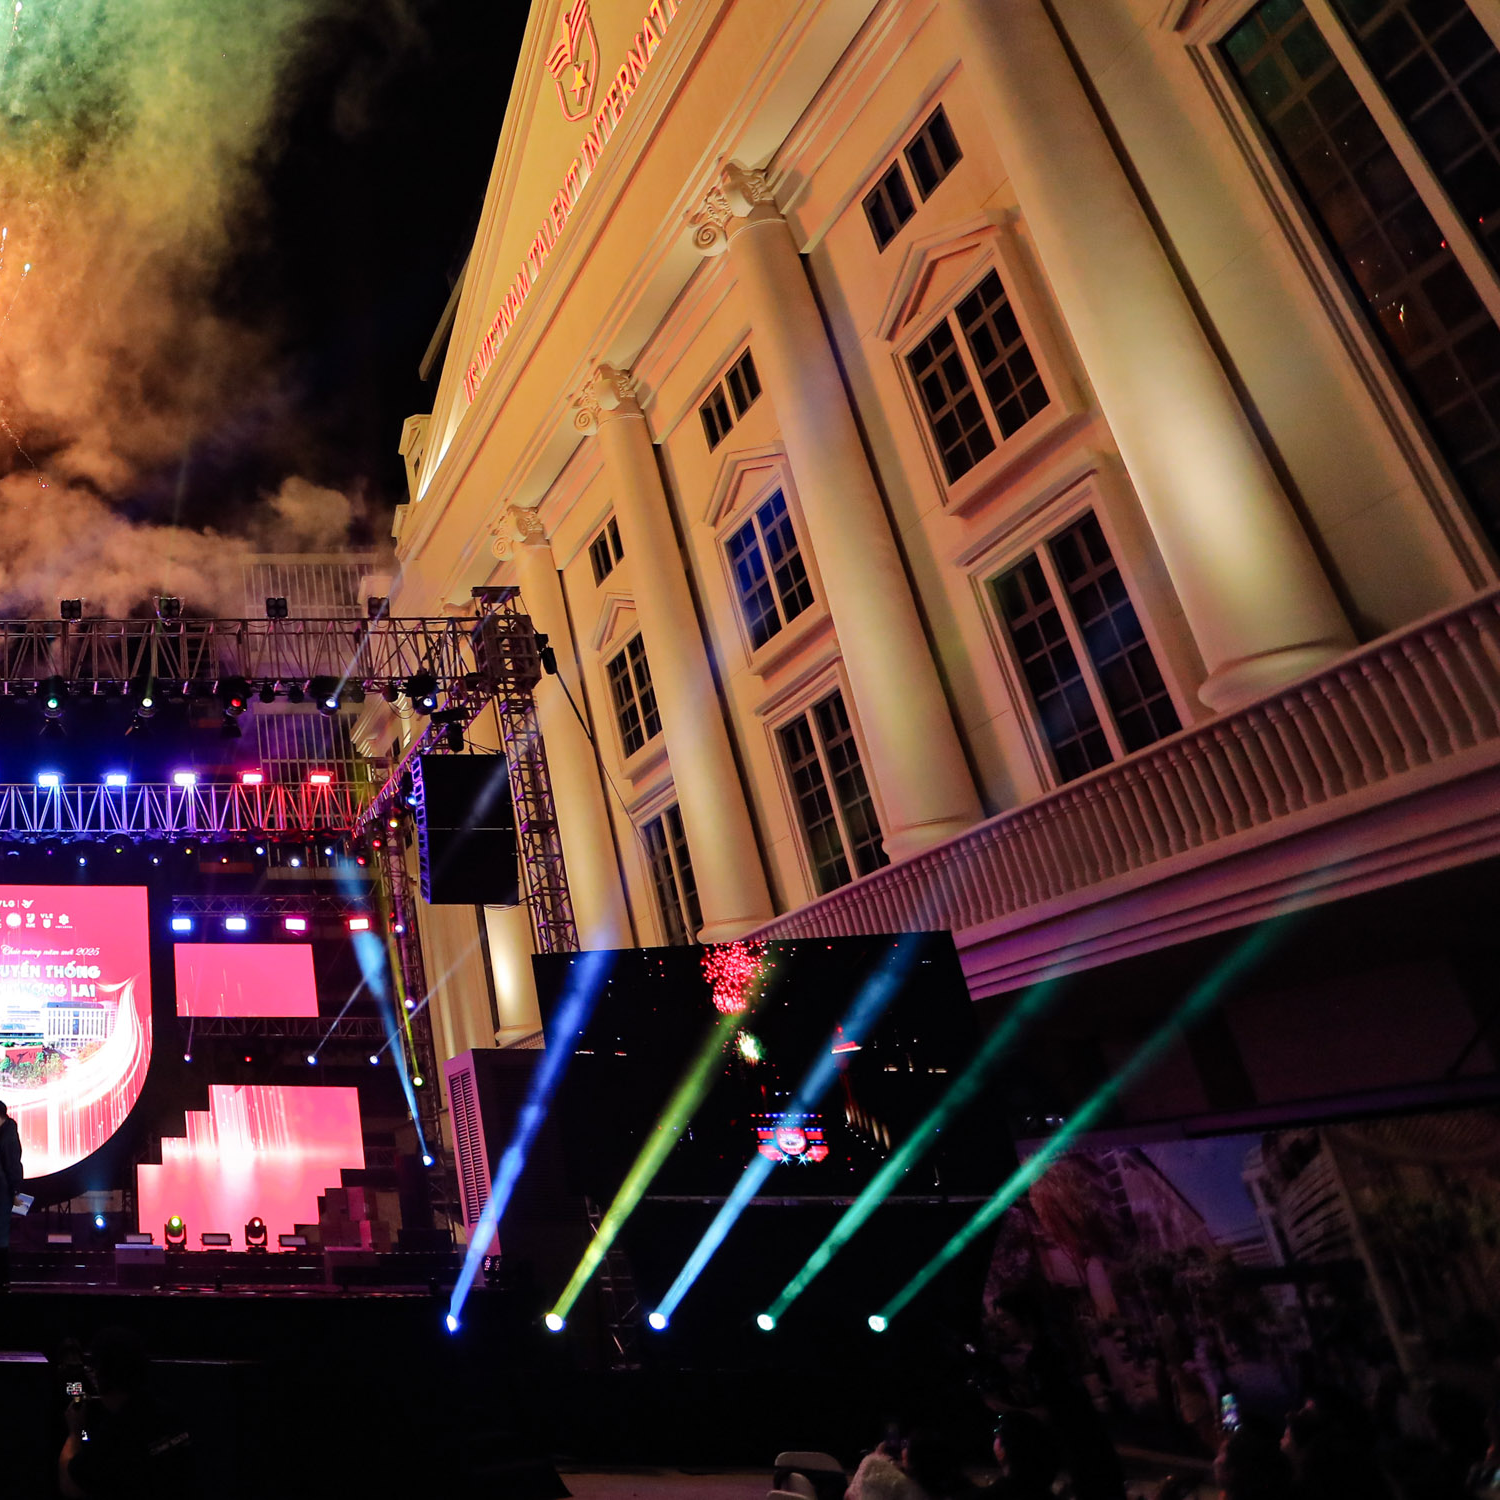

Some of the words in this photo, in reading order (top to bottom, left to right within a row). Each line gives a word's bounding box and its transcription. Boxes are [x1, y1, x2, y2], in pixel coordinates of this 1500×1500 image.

[463, 361, 481, 406] US
[477, 261, 532, 377] VIETNAM
[528, 157, 580, 277] TALENT
[75, 947, 100, 956] 2025
[45, 960, 102, 979] THỐNG
[71, 982, 96, 998] LAI
